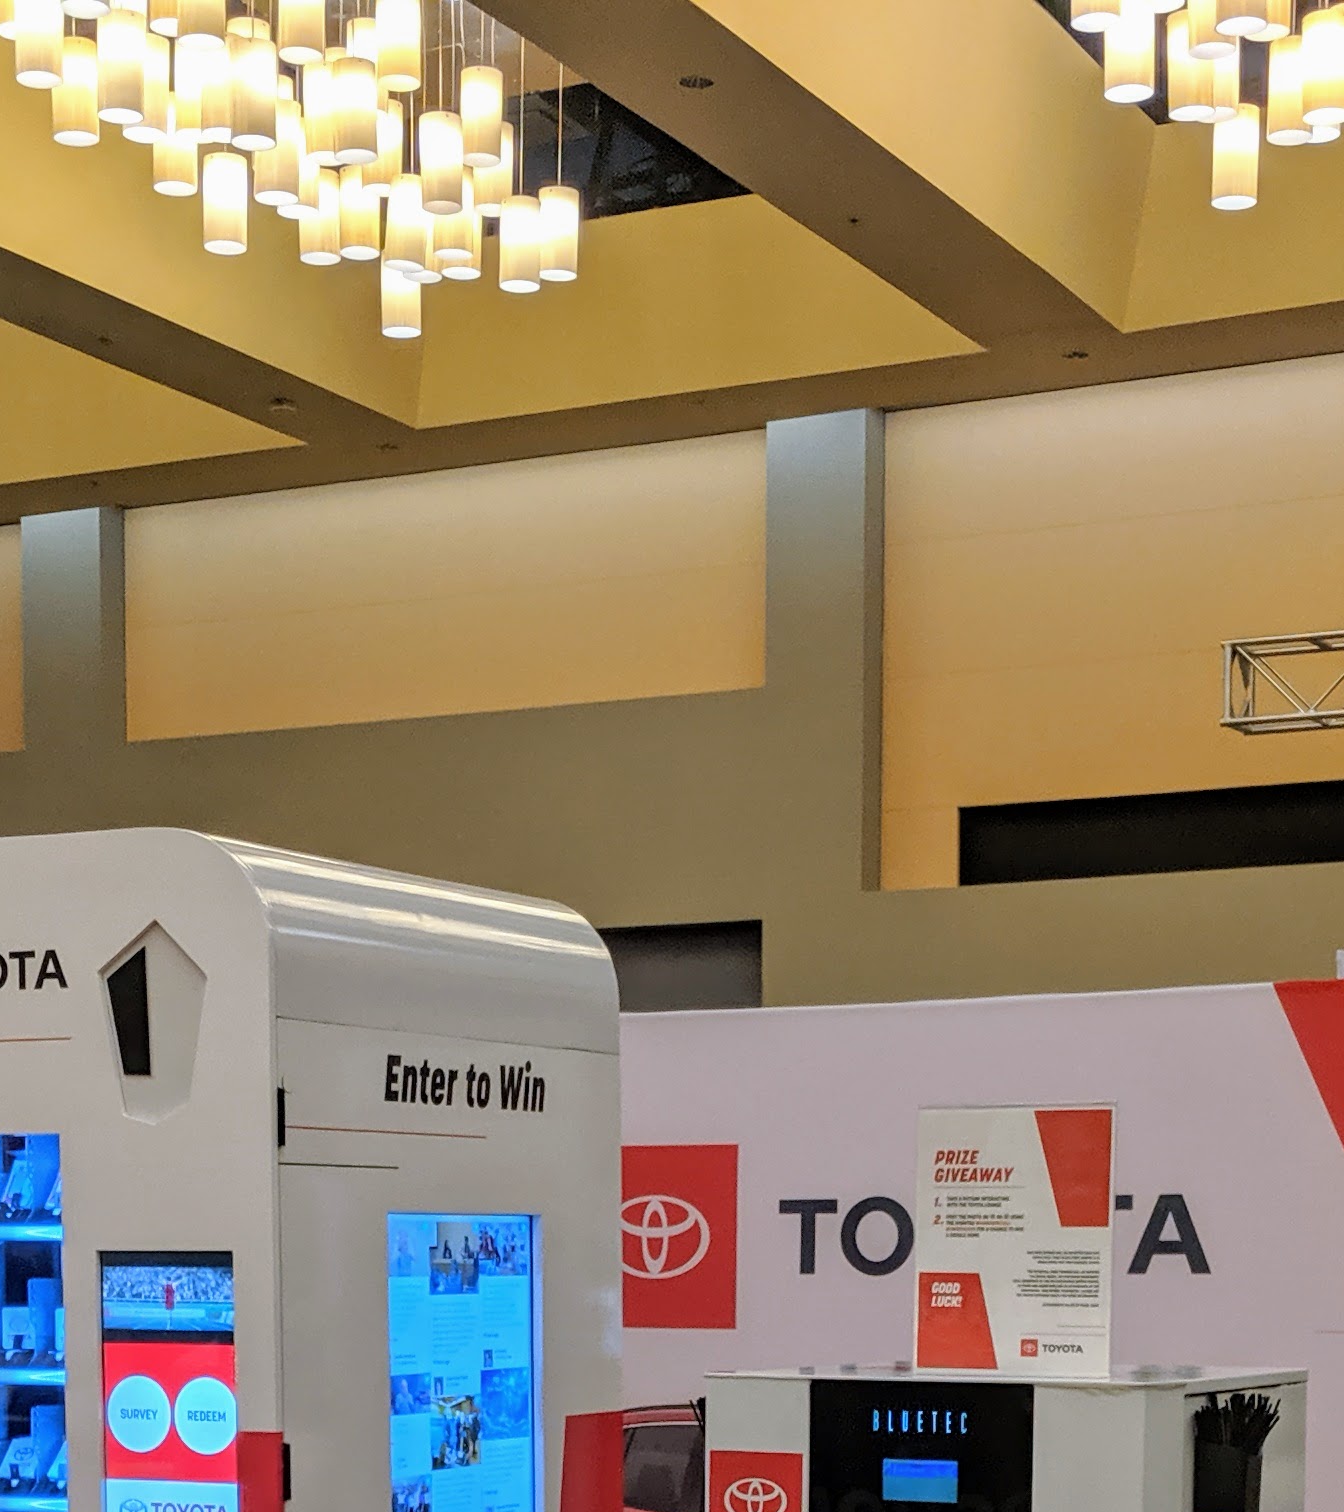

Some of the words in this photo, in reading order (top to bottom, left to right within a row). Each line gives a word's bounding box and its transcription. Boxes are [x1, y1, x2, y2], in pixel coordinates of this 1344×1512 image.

[384, 1054, 459, 1109] Enter
[465, 1068, 491, 1109] to
[499, 1061, 546, 1113] Win
[934, 1150, 979, 1165] PRIZE
[934, 1167, 1014, 1183] GIVEAWAY
[931, 1282, 960, 1294] GOOD
[931, 1295, 964, 1307] LUCK!
[1042, 1344, 1084, 1354] TOYOTA
[120, 1408, 158, 1420] SURVEY
[187, 1410, 227, 1422] REDEEM
[872, 1409, 968, 1434] BLUETEC
